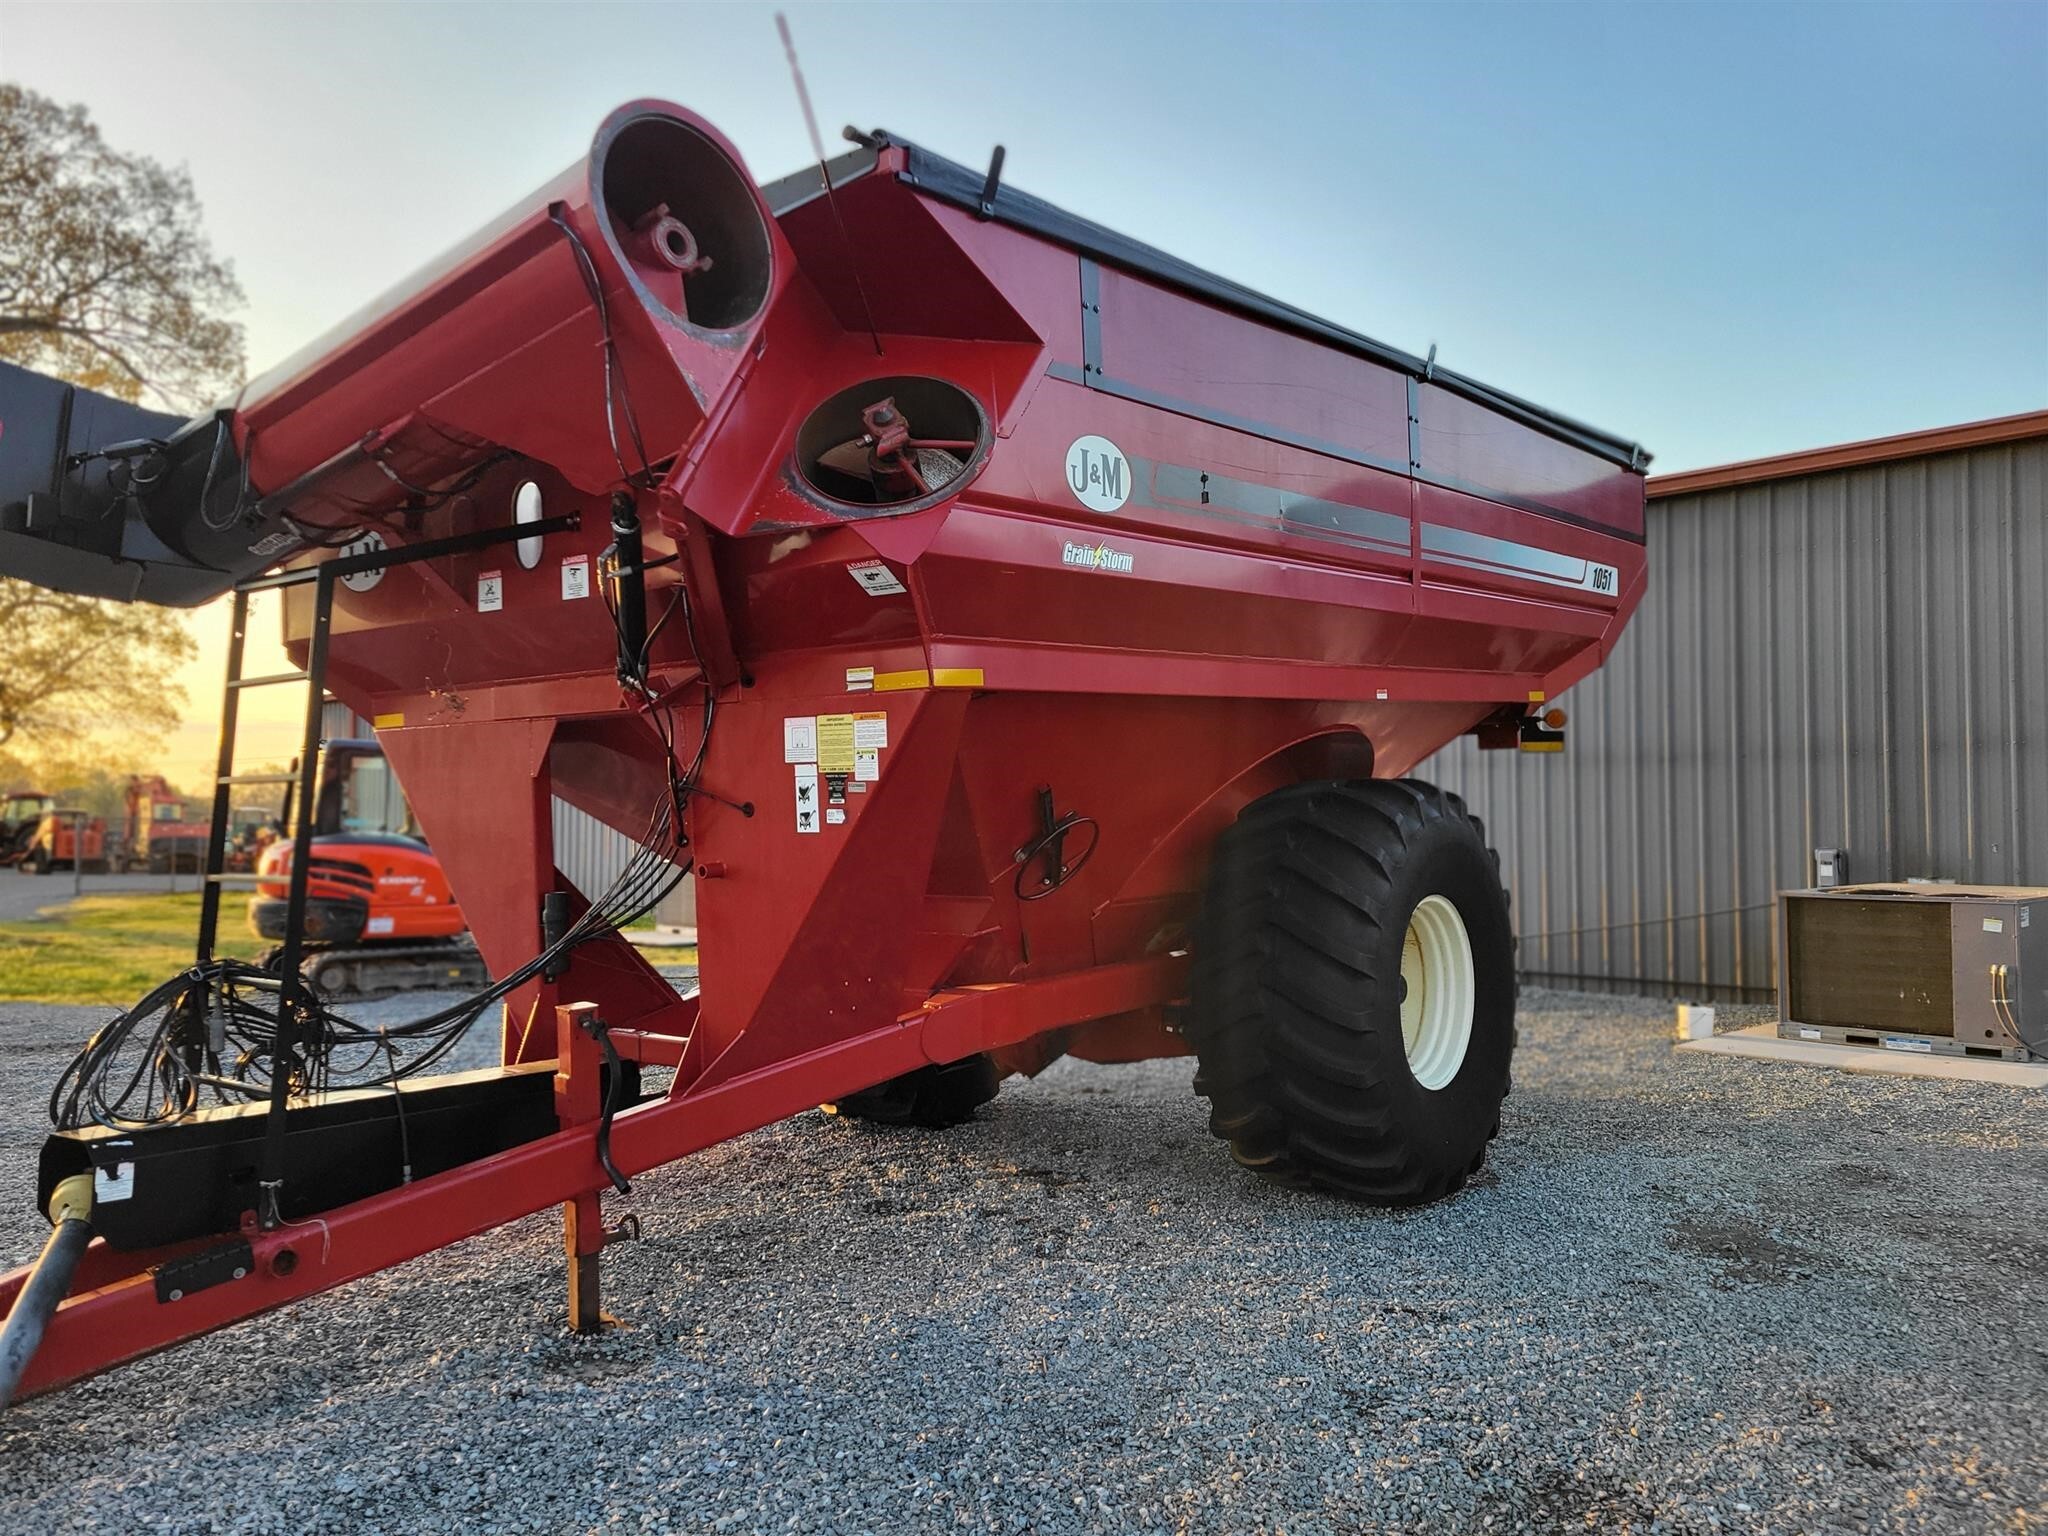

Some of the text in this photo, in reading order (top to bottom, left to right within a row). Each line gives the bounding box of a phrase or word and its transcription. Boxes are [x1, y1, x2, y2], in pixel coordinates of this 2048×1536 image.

[1070, 448, 1123, 500] J&M
[850, 560, 883, 568] DANGER
[1063, 540, 1134, 573] Grain Storm
[1592, 567, 1612, 591] 1051
